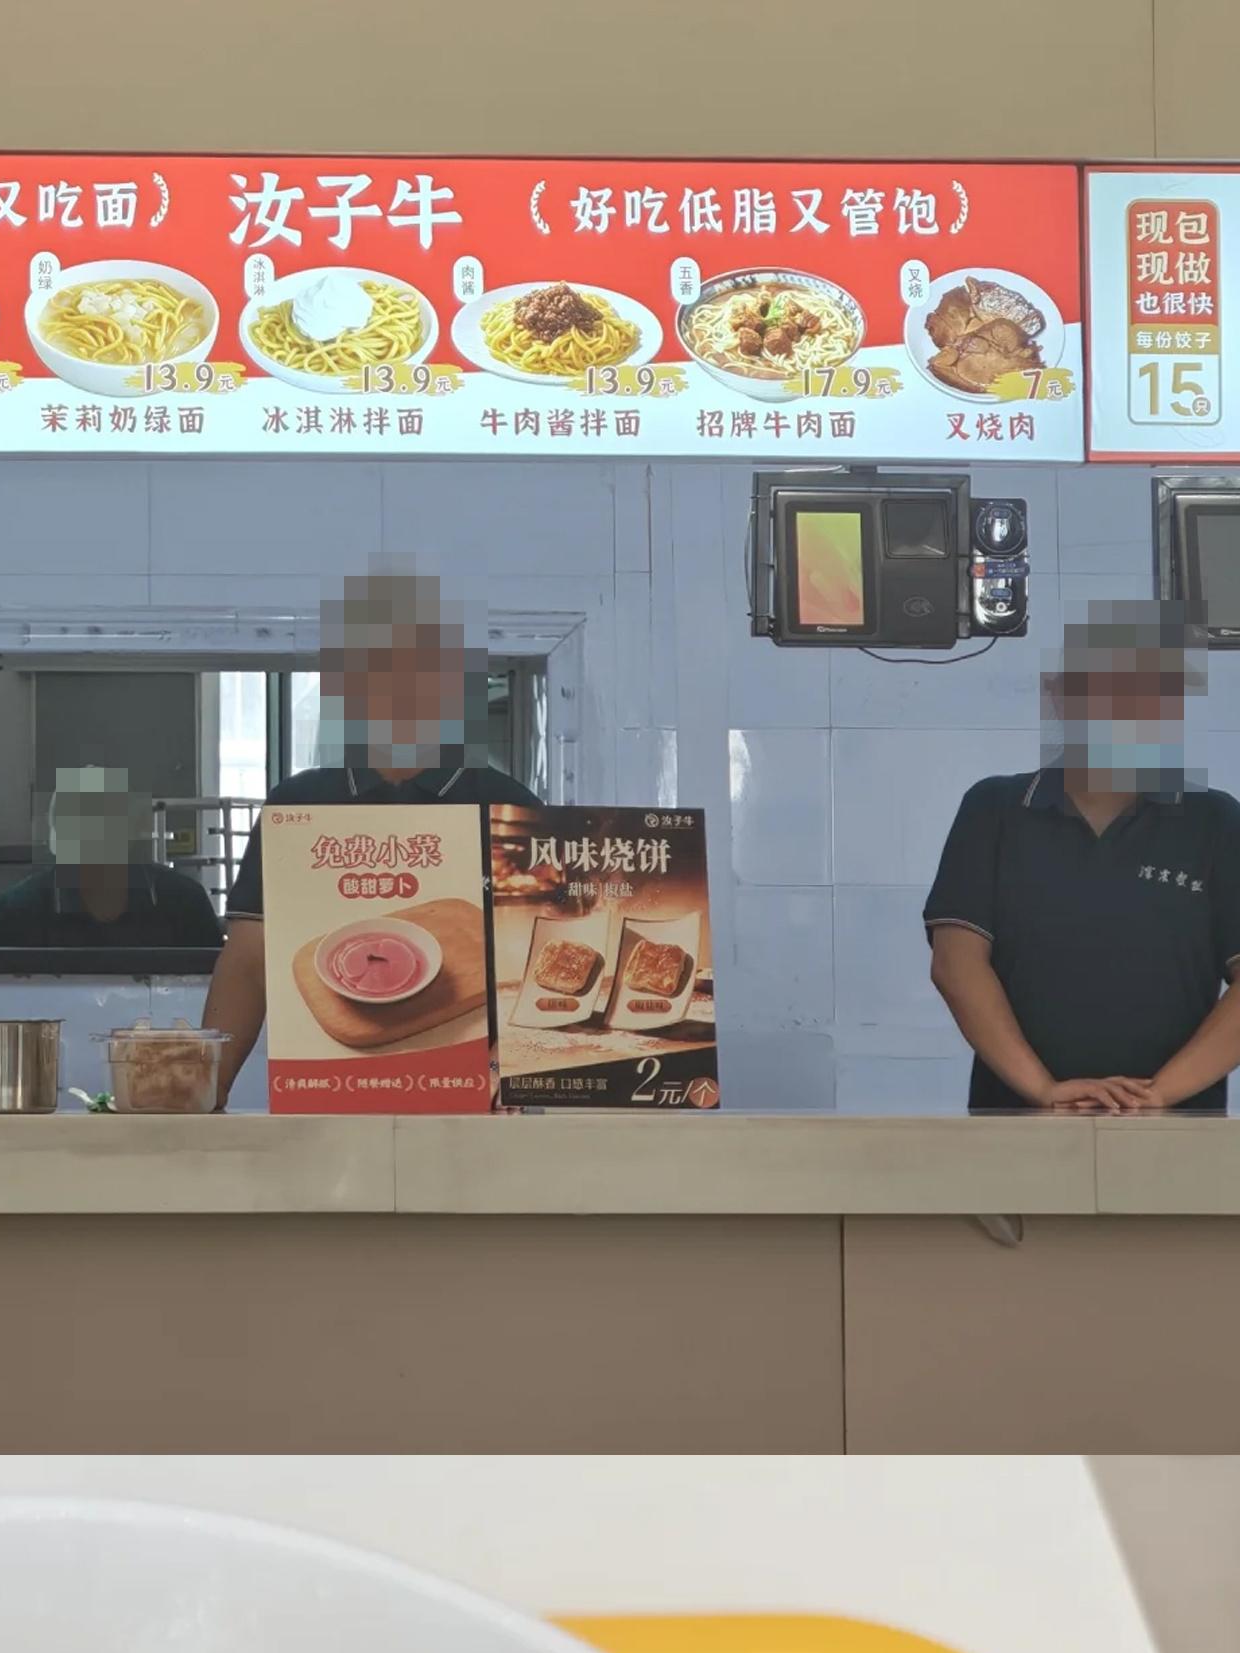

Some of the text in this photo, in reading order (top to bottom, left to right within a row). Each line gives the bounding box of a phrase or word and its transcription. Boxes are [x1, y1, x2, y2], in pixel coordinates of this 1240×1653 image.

[228, 172, 462, 250] 汝子牛
[569, 186, 939, 237] 好吃低脂又管饱
[1135, 210, 1211, 245] 现包
[37, 259, 54, 291] 奶绿
[252, 257, 268, 297] 冰淇淋
[460, 265, 475, 296] 肉酱
[678, 265, 694, 297] 五香
[907, 267, 924, 299] 叉烧
[1135, 251, 1212, 286] 现做
[1135, 292, 1214, 316] 也很快
[1135, 331, 1212, 349] 每份饺子
[40, 404, 205, 435] 茉莉奶绿面
[261, 406, 424, 436] 冰淇淋拌面
[479, 408, 641, 438] 牛肉酱拌面
[696, 409, 857, 439] 招牌牛肉面
[945, 411, 1036, 441] 叉烧肉
[310, 835, 444, 869] 免费小菜
[528, 836, 672, 874] 风味烧饼
[342, 877, 416, 897] 酸甜萝卜
[568, 881, 598, 898] 甜味
[630, 1055, 716, 1106] 2元/个
